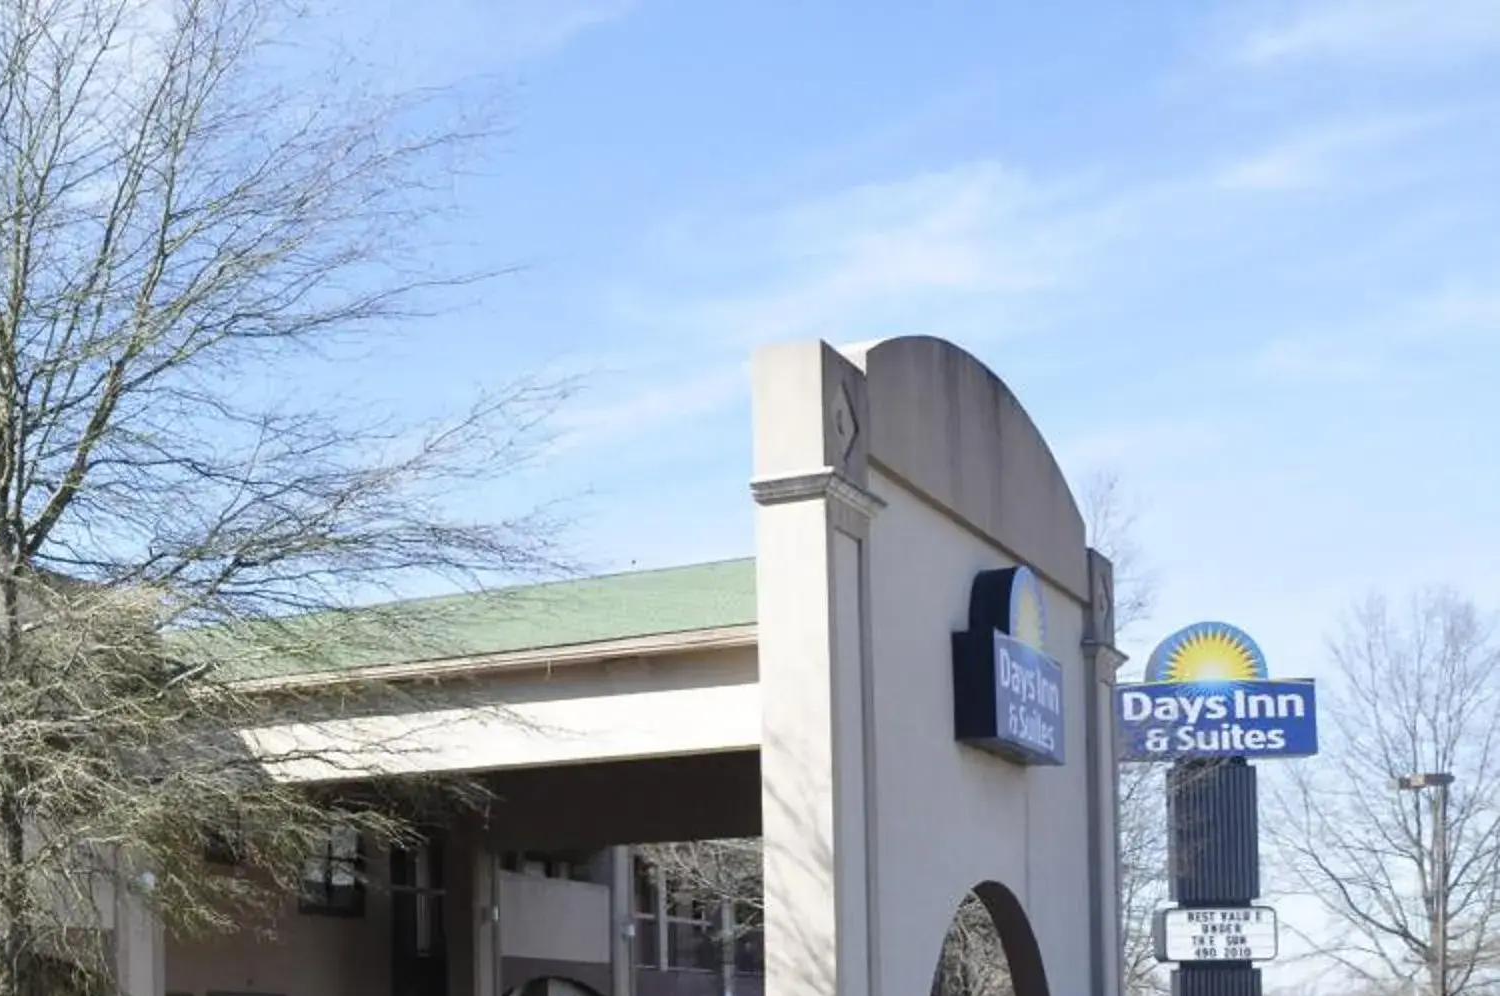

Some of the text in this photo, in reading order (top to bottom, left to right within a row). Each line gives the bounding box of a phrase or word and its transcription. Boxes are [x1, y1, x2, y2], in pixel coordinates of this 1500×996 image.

[1000, 647, 1059, 716] Days Inn
[1009, 701, 1055, 752] & Suites
[1122, 689, 1305, 724] Days Inn
[1145, 723, 1286, 752] & Suites
